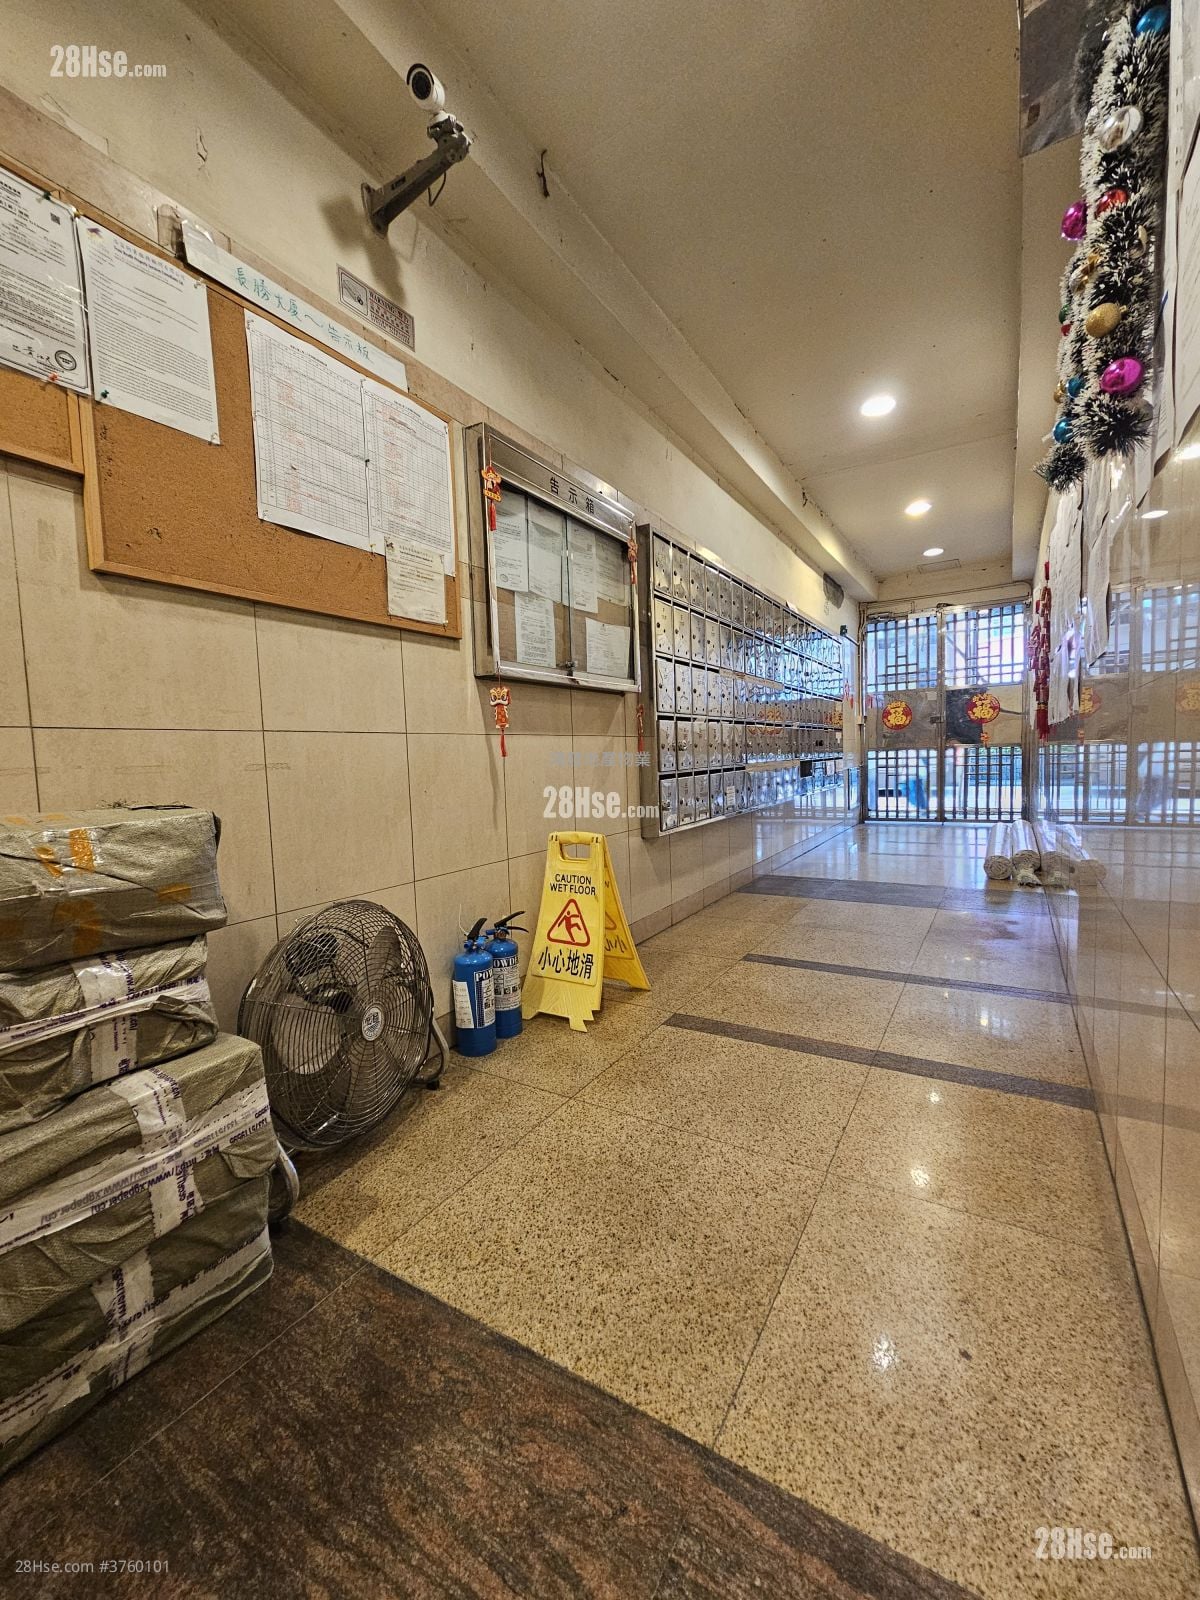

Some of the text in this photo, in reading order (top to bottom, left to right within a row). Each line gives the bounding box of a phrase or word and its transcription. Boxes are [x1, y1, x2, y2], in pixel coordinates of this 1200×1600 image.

[549, 476, 595, 515] 告示箱
[550, 882, 568, 893] WET
[569, 884, 596, 896] FLOOR
[555, 873, 592, 885] CAUTION
[538, 946, 594, 979] 小心地滑
